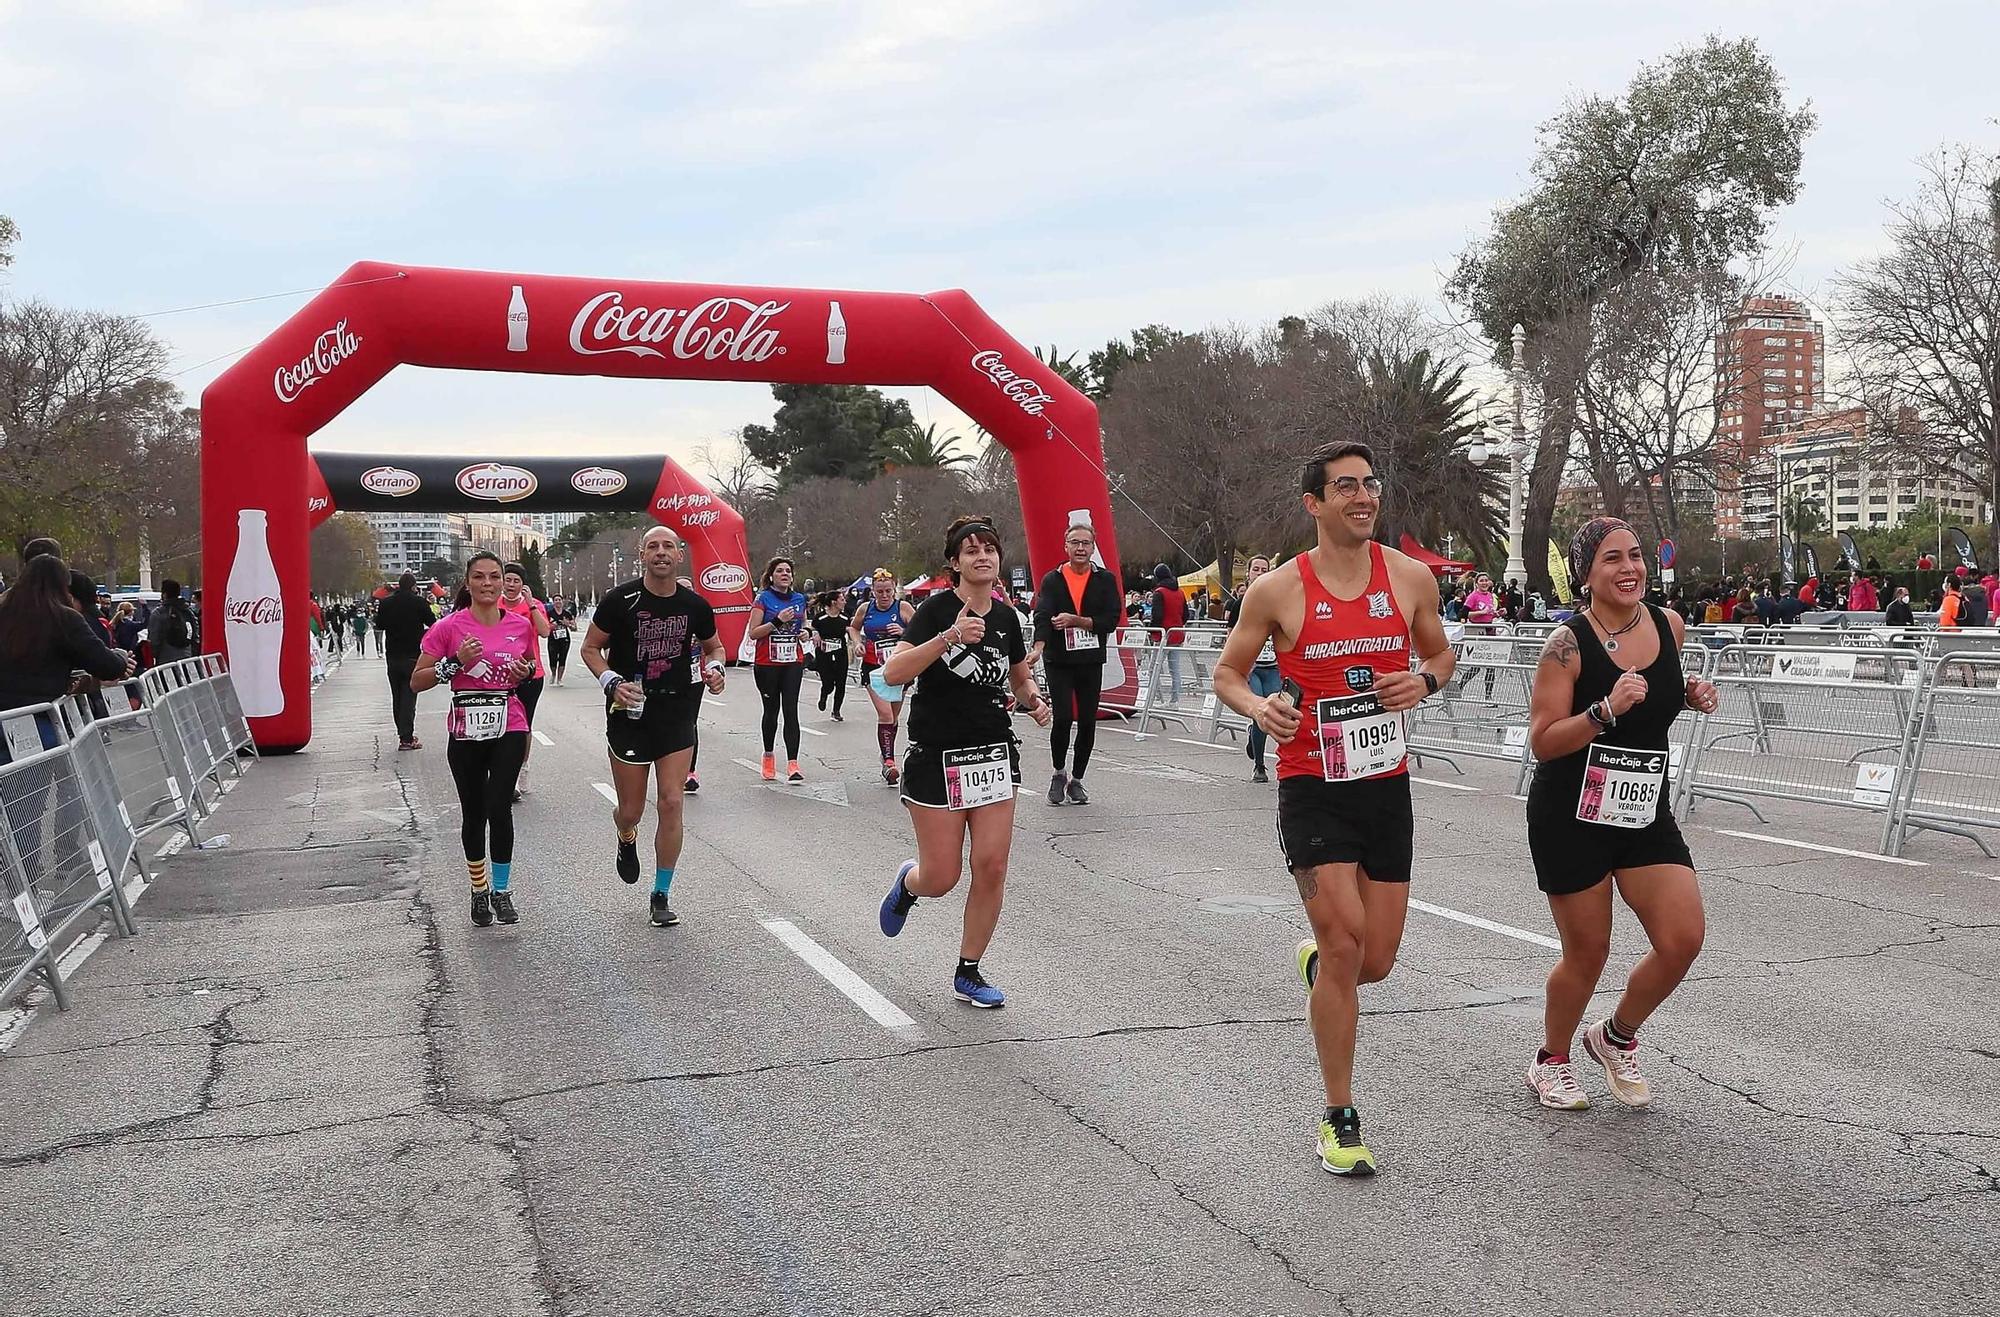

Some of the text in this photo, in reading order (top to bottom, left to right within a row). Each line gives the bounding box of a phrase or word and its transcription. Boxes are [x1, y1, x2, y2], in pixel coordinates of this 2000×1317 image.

[568, 291, 792, 362] Coca-Cola
[273, 315, 360, 403] Coca-Cola
[971, 350, 1057, 415] Coca-Cola
[368, 474, 415, 488] Serrano
[465, 473, 530, 490] Serrano
[578, 474, 622, 488] Serrano
[656, 493, 712, 511] COME BIEN
[705, 573, 745, 586] Serrano
[1348, 669, 1371, 684] BR
[1329, 701, 1375, 717] iberCaja
[468, 711, 501, 725] 11261
[1348, 720, 1397, 751] 10992
[951, 752, 985, 763] iberCaja
[1370, 747, 1385, 757] LUIS
[1333, 762, 1346, 774] 05
[1599, 752, 1642, 769] iberCaja
[964, 767, 1005, 788] 10475
[1610, 780, 1655, 803] 10685
